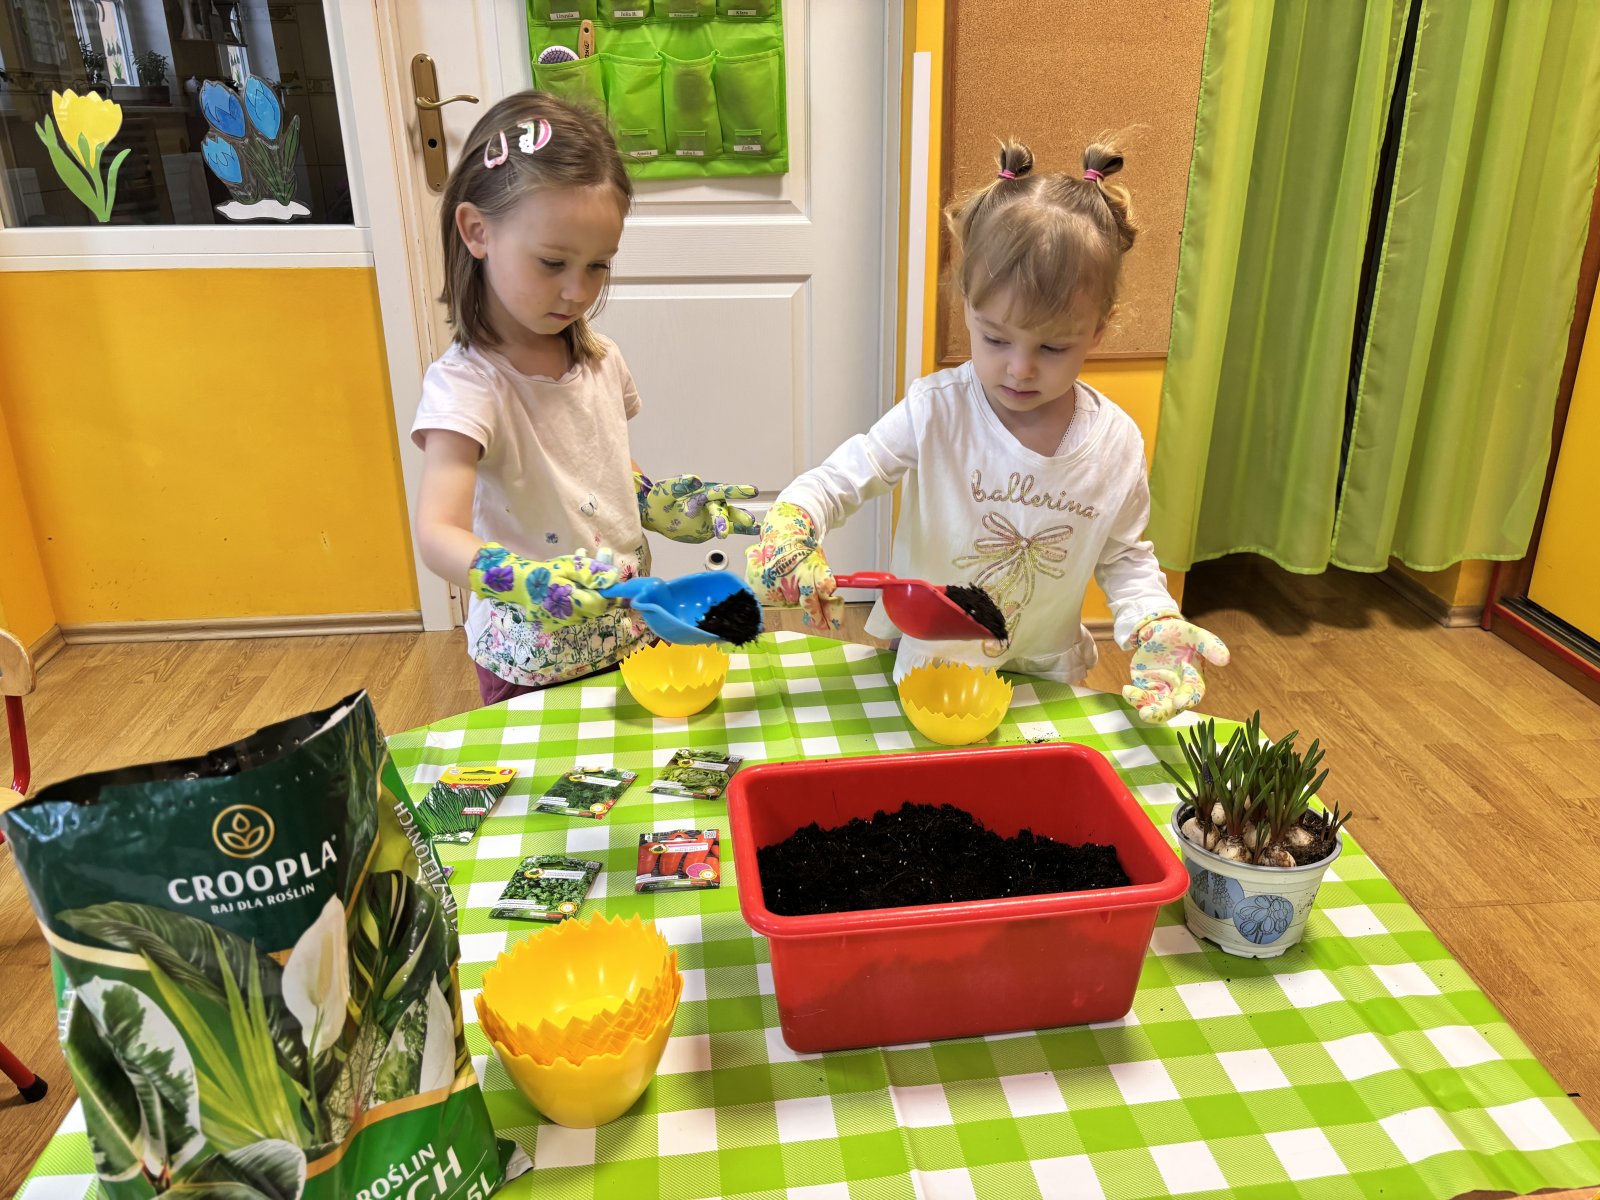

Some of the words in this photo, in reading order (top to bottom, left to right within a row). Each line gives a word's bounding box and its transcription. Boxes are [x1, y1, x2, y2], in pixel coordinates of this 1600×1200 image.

[971, 469, 1100, 519] ballerina
[167, 840, 338, 904] CROOPLA
[393, 801, 449, 894] ZIELONYCH
[210, 903, 234, 915] RAJ
[236, 897, 264, 912] DLA
[266, 882, 316, 906] ROŚLIN
